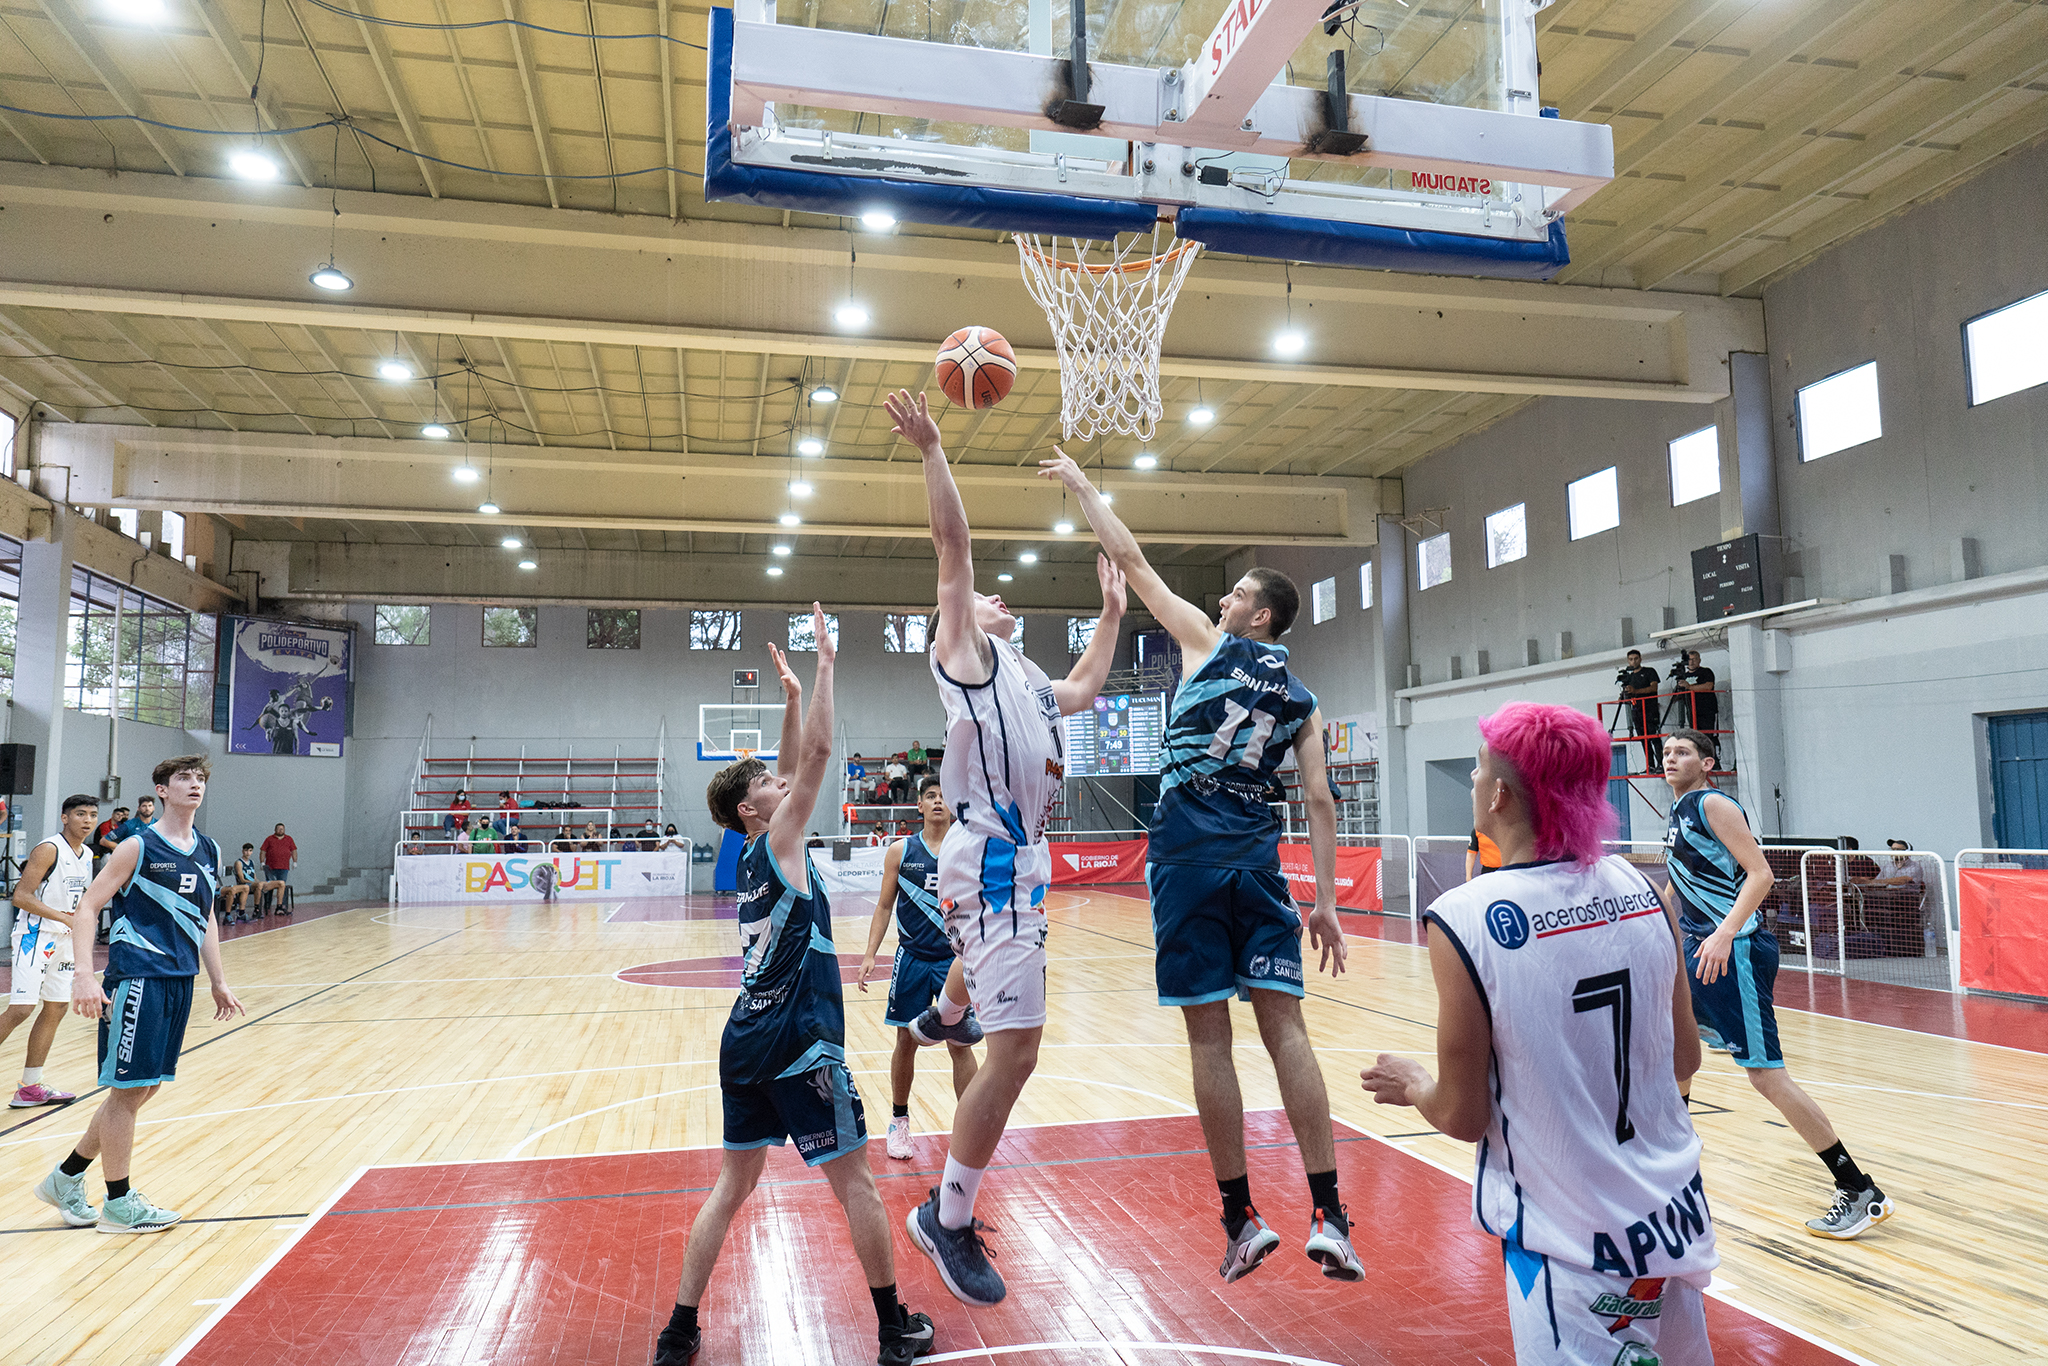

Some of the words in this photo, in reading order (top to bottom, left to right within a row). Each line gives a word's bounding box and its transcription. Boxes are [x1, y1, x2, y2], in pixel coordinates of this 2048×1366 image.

[1717, 543, 1732, 552] TIEMPO
[1702, 571, 1717, 580] LOCAL
[1735, 563, 1750, 571] VISITA
[261, 634, 328, 657] POLIDEPORTIVO
[275, 650, 313, 659] EVITA
[1230, 667, 1261, 692] SAN
[1206, 697, 1277, 771] 11
[1105, 740, 1123, 750] 7:49
[1081, 860, 1092, 869] LA
[1094, 860, 1118, 868] RIOJA
[178, 873, 198, 894] 9
[465, 857, 622, 895] BASQUET
[1531, 890, 1658, 932] acerosfigueroa
[740, 916, 772, 977] 7
[1274, 965, 1290, 977] SAN
[1290, 970, 1302, 981] LUIS
[118, 1020, 135, 1063] SAN
[1572, 967, 1635, 1146] 7
[797, 1131, 825, 1145] GOBIERNO
[799, 1141, 816, 1154] SAN
[816, 1136, 835, 1148] LUIS
[1596, 1295, 1662, 1316] Gatorad
